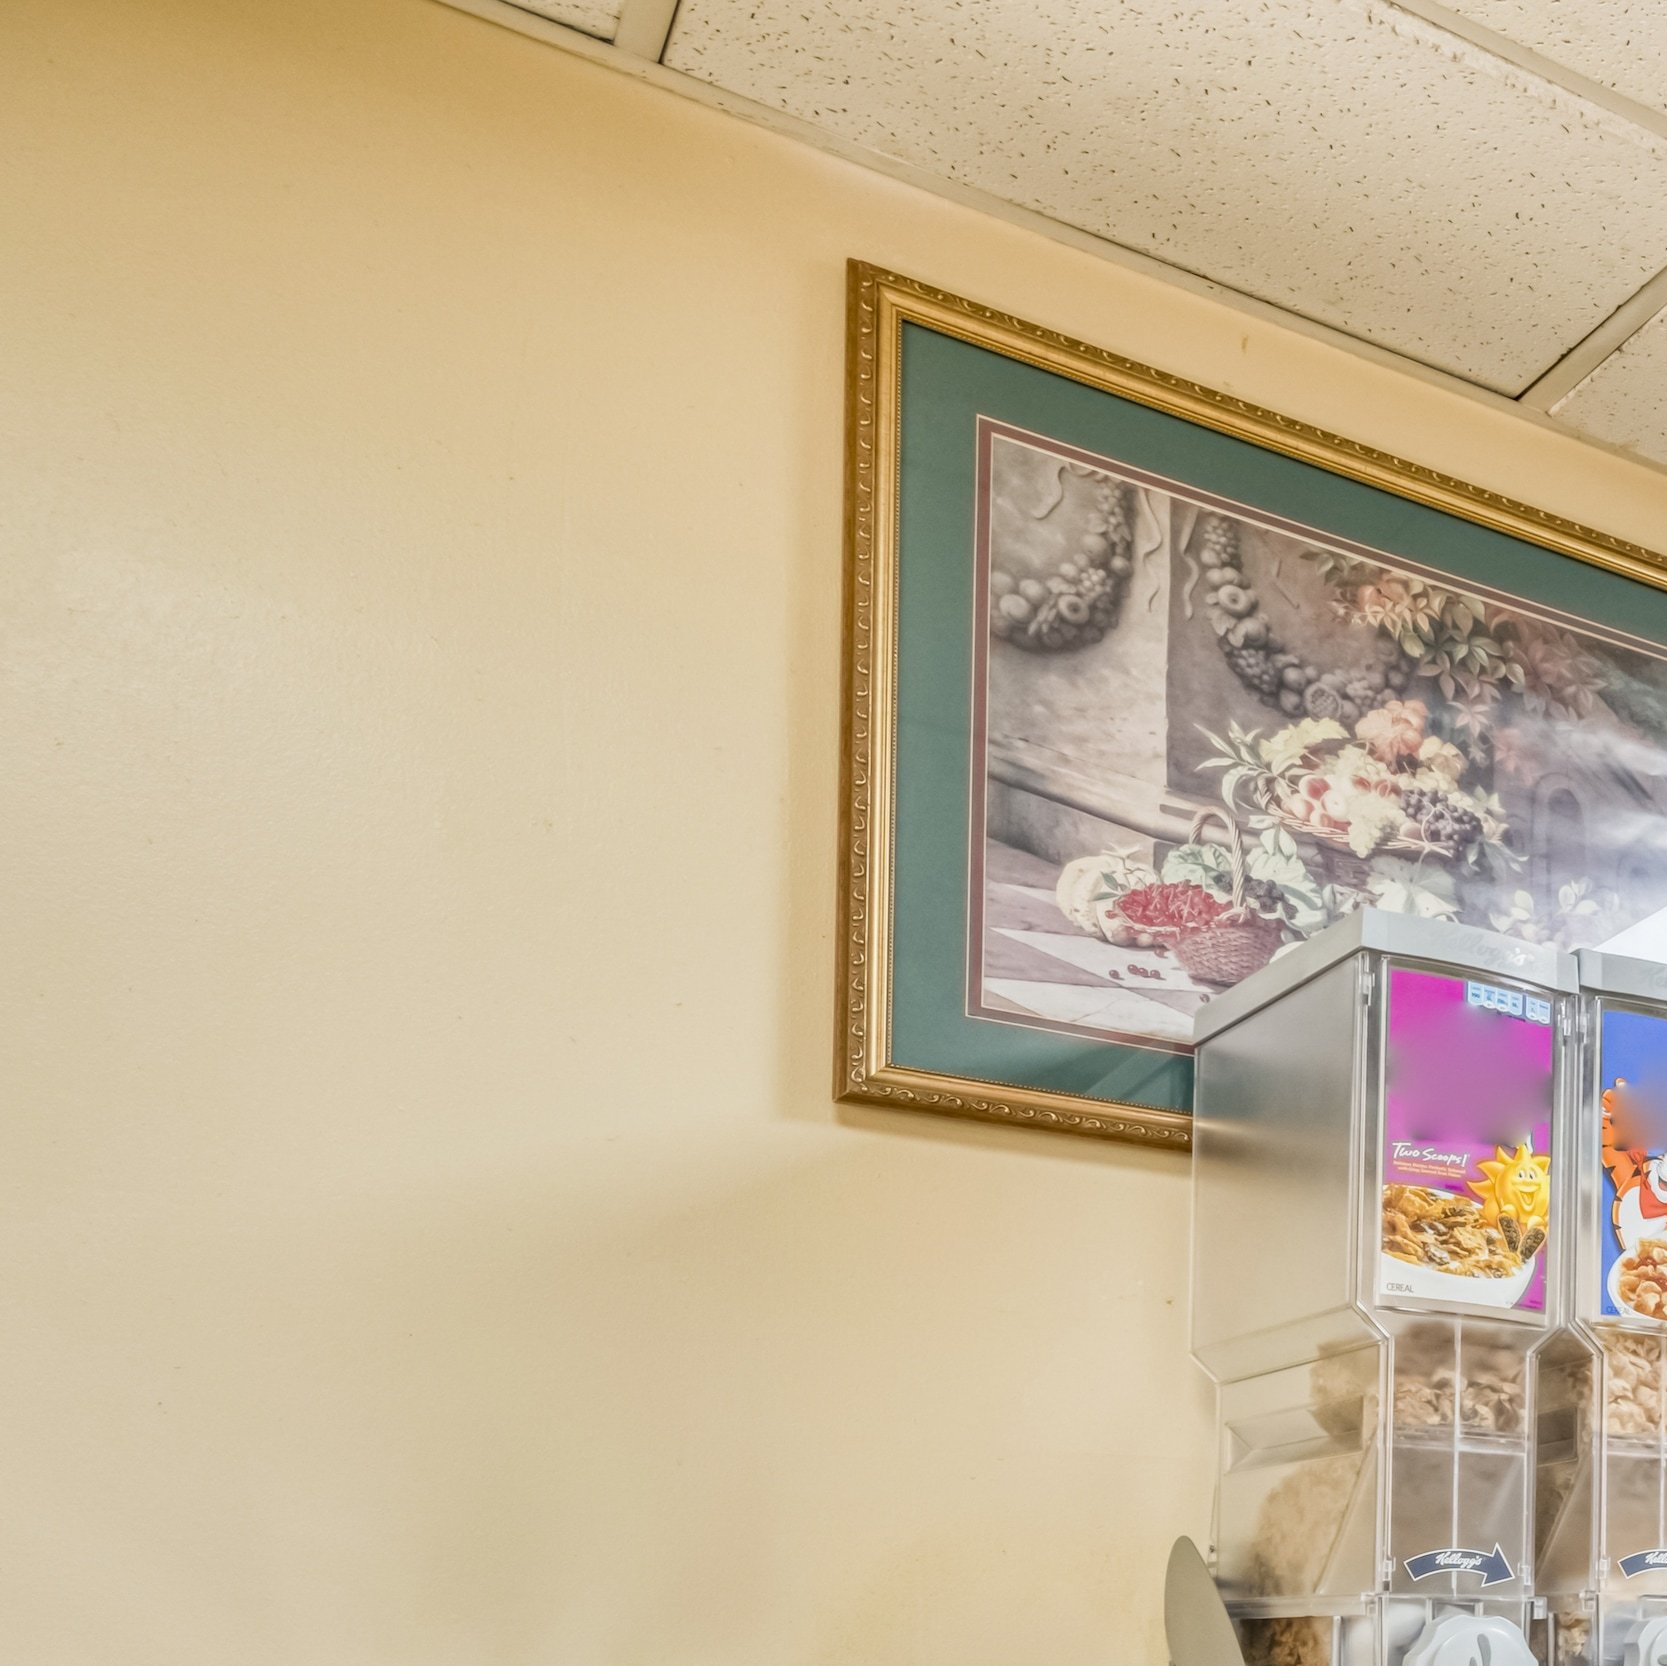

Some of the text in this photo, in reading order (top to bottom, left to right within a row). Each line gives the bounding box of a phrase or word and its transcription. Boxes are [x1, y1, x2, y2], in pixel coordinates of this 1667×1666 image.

[1392, 1142, 1420, 1159] Two
[1386, 1282, 1414, 1293] CEREAL
[1435, 1552, 1483, 1568] Kellogg's
